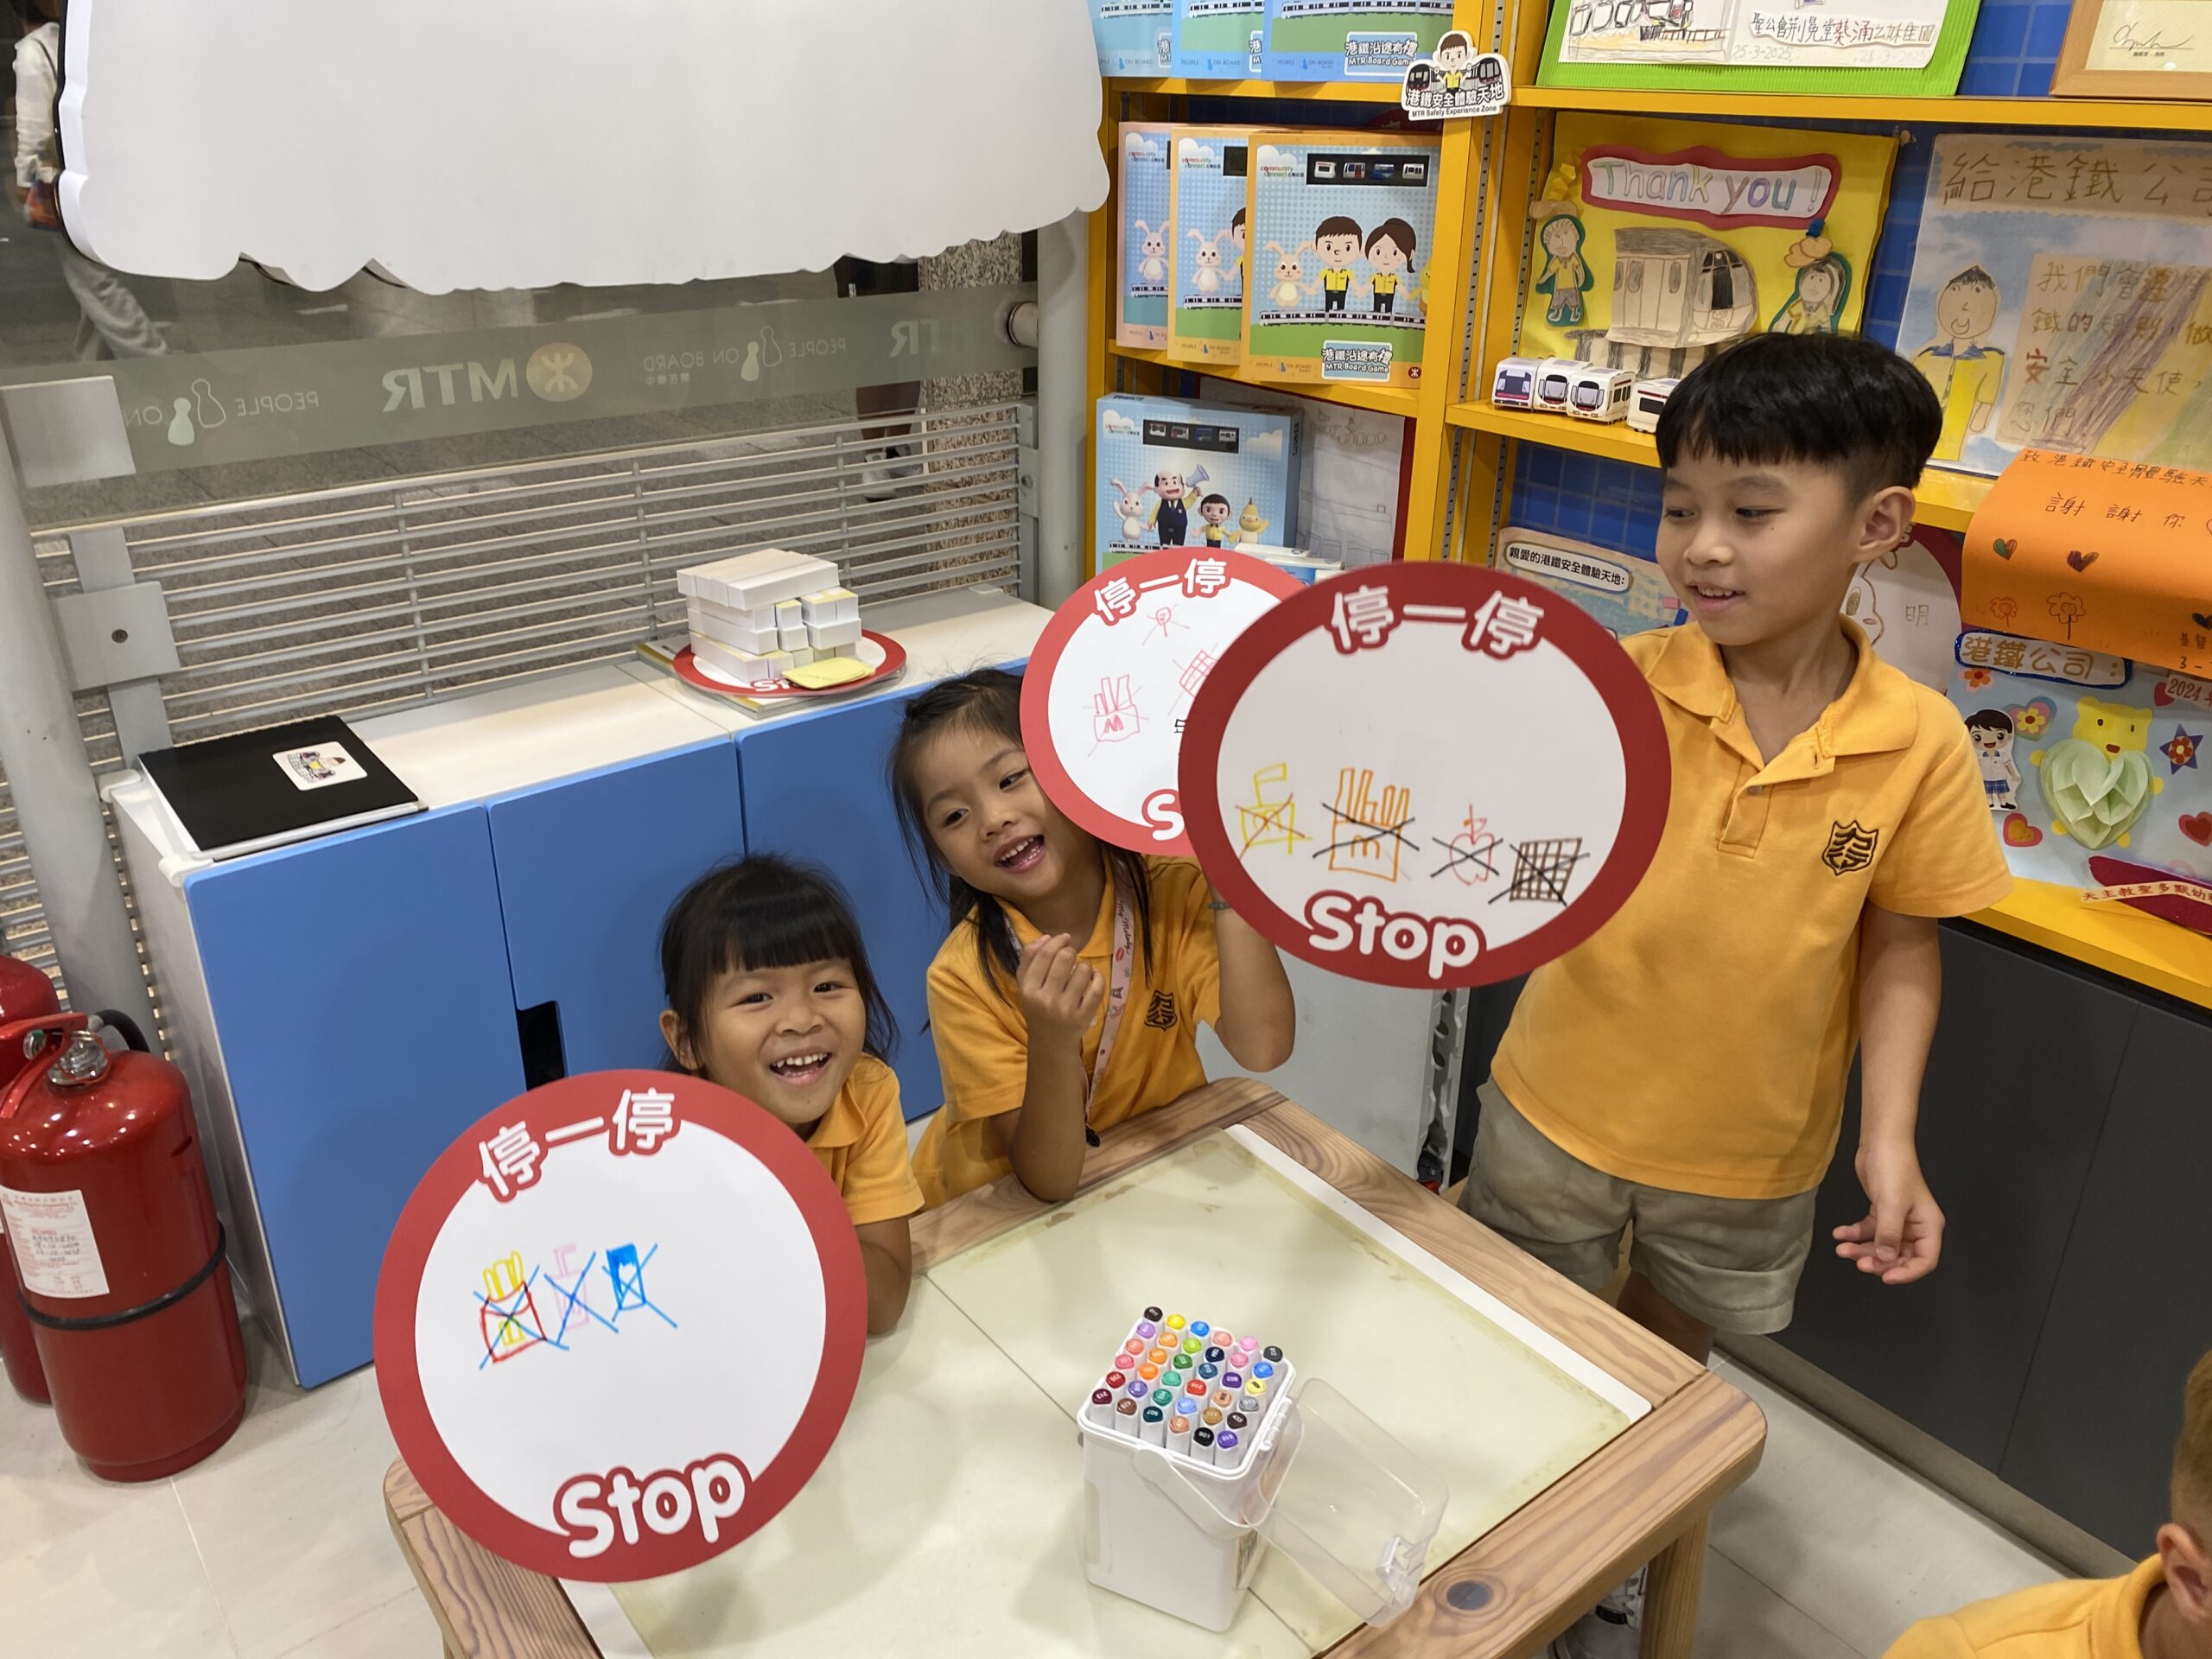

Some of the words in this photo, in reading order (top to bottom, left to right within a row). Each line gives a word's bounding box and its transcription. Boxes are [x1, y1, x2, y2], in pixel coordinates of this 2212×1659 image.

[1344, 39, 1420, 59] 港鐵沿途有禮
[1348, 55, 1367, 67] MTR
[1368, 56, 1391, 67] Board
[1406, 82, 1505, 108] 港鐵安全體驗天地
[1411, 110, 1426, 118] MTR
[1426, 109, 1446, 118] Safety
[1446, 106, 1480, 116] Experience
[1480, 105, 1497, 113] Zone
[1592, 161, 1713, 204] Thank
[1719, 175, 1797, 215] you
[1321, 347, 1394, 366] 港鐵沿途有禮
[1325, 362, 1344, 372] MTR
[1344, 362, 1367, 372] Board
[1367, 363, 1390, 374] Game
[2018, 448, 2212, 486] 致港鐵安全體驗天
[2044, 491, 2186, 530] 謝謝你
[1094, 557, 1229, 623] 停一停
[1330, 584, 1545, 657] 停一停
[1904, 604, 1929, 627] 明
[1307, 893, 1481, 980] Stop
[478, 1087, 677, 1198] 停一停
[560, 1458, 747, 1559] Stop
